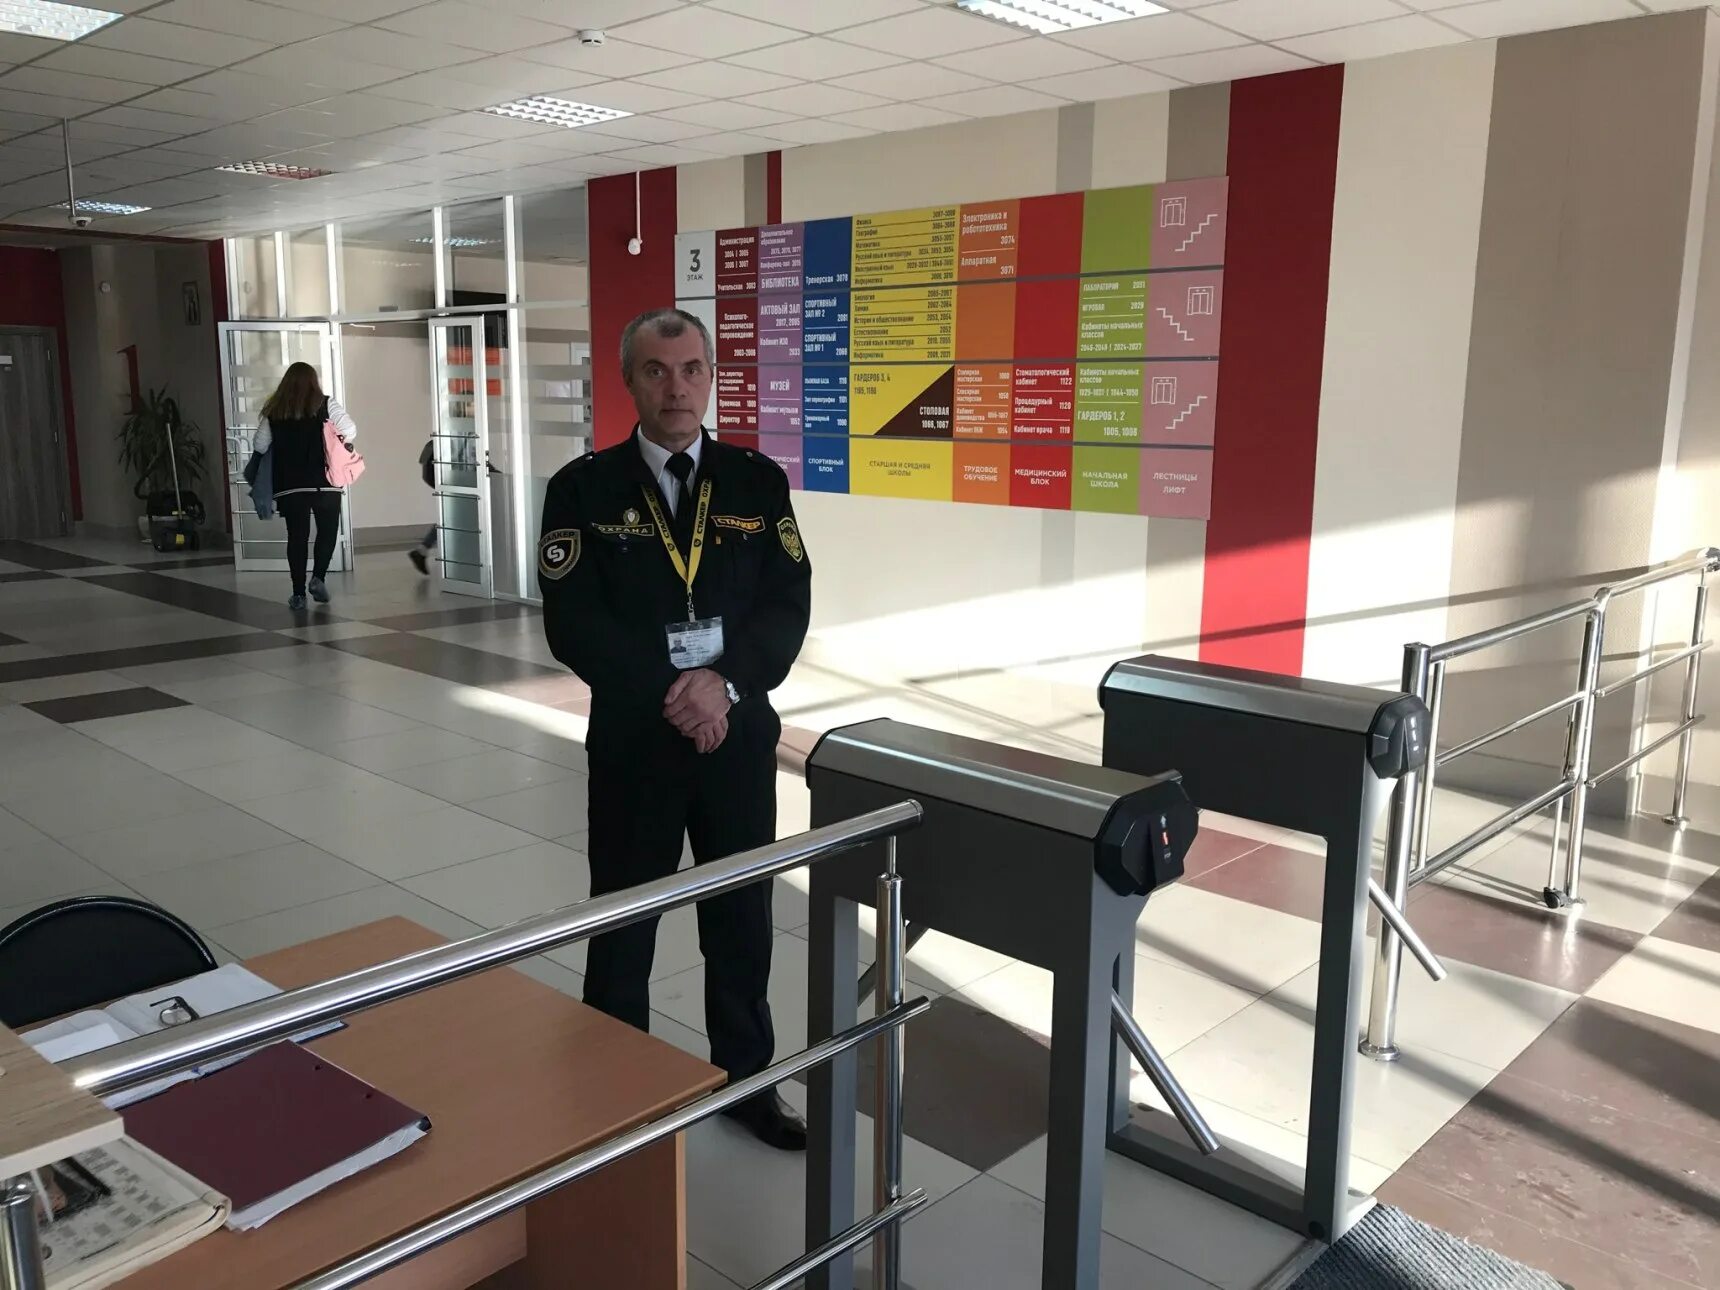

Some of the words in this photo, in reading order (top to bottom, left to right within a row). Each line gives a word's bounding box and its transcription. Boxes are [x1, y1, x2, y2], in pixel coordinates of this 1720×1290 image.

[963, 212, 1002, 223] Электроника
[962, 223, 1007, 235] робототехника
[1001, 235, 1015, 244] 3074
[690, 249, 700, 272] 3
[961, 256, 997, 267] Аппаратная
[761, 276, 799, 289] БИБЛИОТЕКА
[760, 302, 788, 315] АКТОВЫЙ
[789, 304, 800, 314] ЗАЛ
[805, 310, 814, 318] ЗАЛ
[1016, 368, 1069, 377] Стоматологический
[770, 379, 790, 391] МУЗЕЙ
[1060, 377, 1072, 385] 1122
[1015, 397, 1053, 406] Процедурный
[919, 406, 950, 416] СТОЛОВАЯ
[1015, 406, 1036, 414] кабинет
[1078, 411, 1112, 422] ГАРДЕРОБ
[1120, 412, 1125, 420] 2
[1014, 425, 1036, 433] Кабинет
[1037, 426, 1052, 435] врача
[808, 457, 844, 465] СПОРТИВНЫЙ
[869, 460, 898, 469] СТАРШАЯ
[888, 469, 911, 477] ШКОЛЫ
[964, 466, 998, 474] ТРУДОВОЕ
[1015, 469, 1067, 478] МЕДИЦИНСКИЙ
[964, 474, 998, 482] ОБУЧЕНИЕ
[1082, 471, 1128, 480] НАЧАЛЬНАЯ
[1153, 472, 1198, 481] ЛЕСТНИЦЫ
[702, 479, 710, 497] ОХРА
[1163, 486, 1186, 494] ЛИФТ
[697, 502, 706, 534] СТАЛКЕР
[717, 518, 760, 530] СТАЛКЕР
